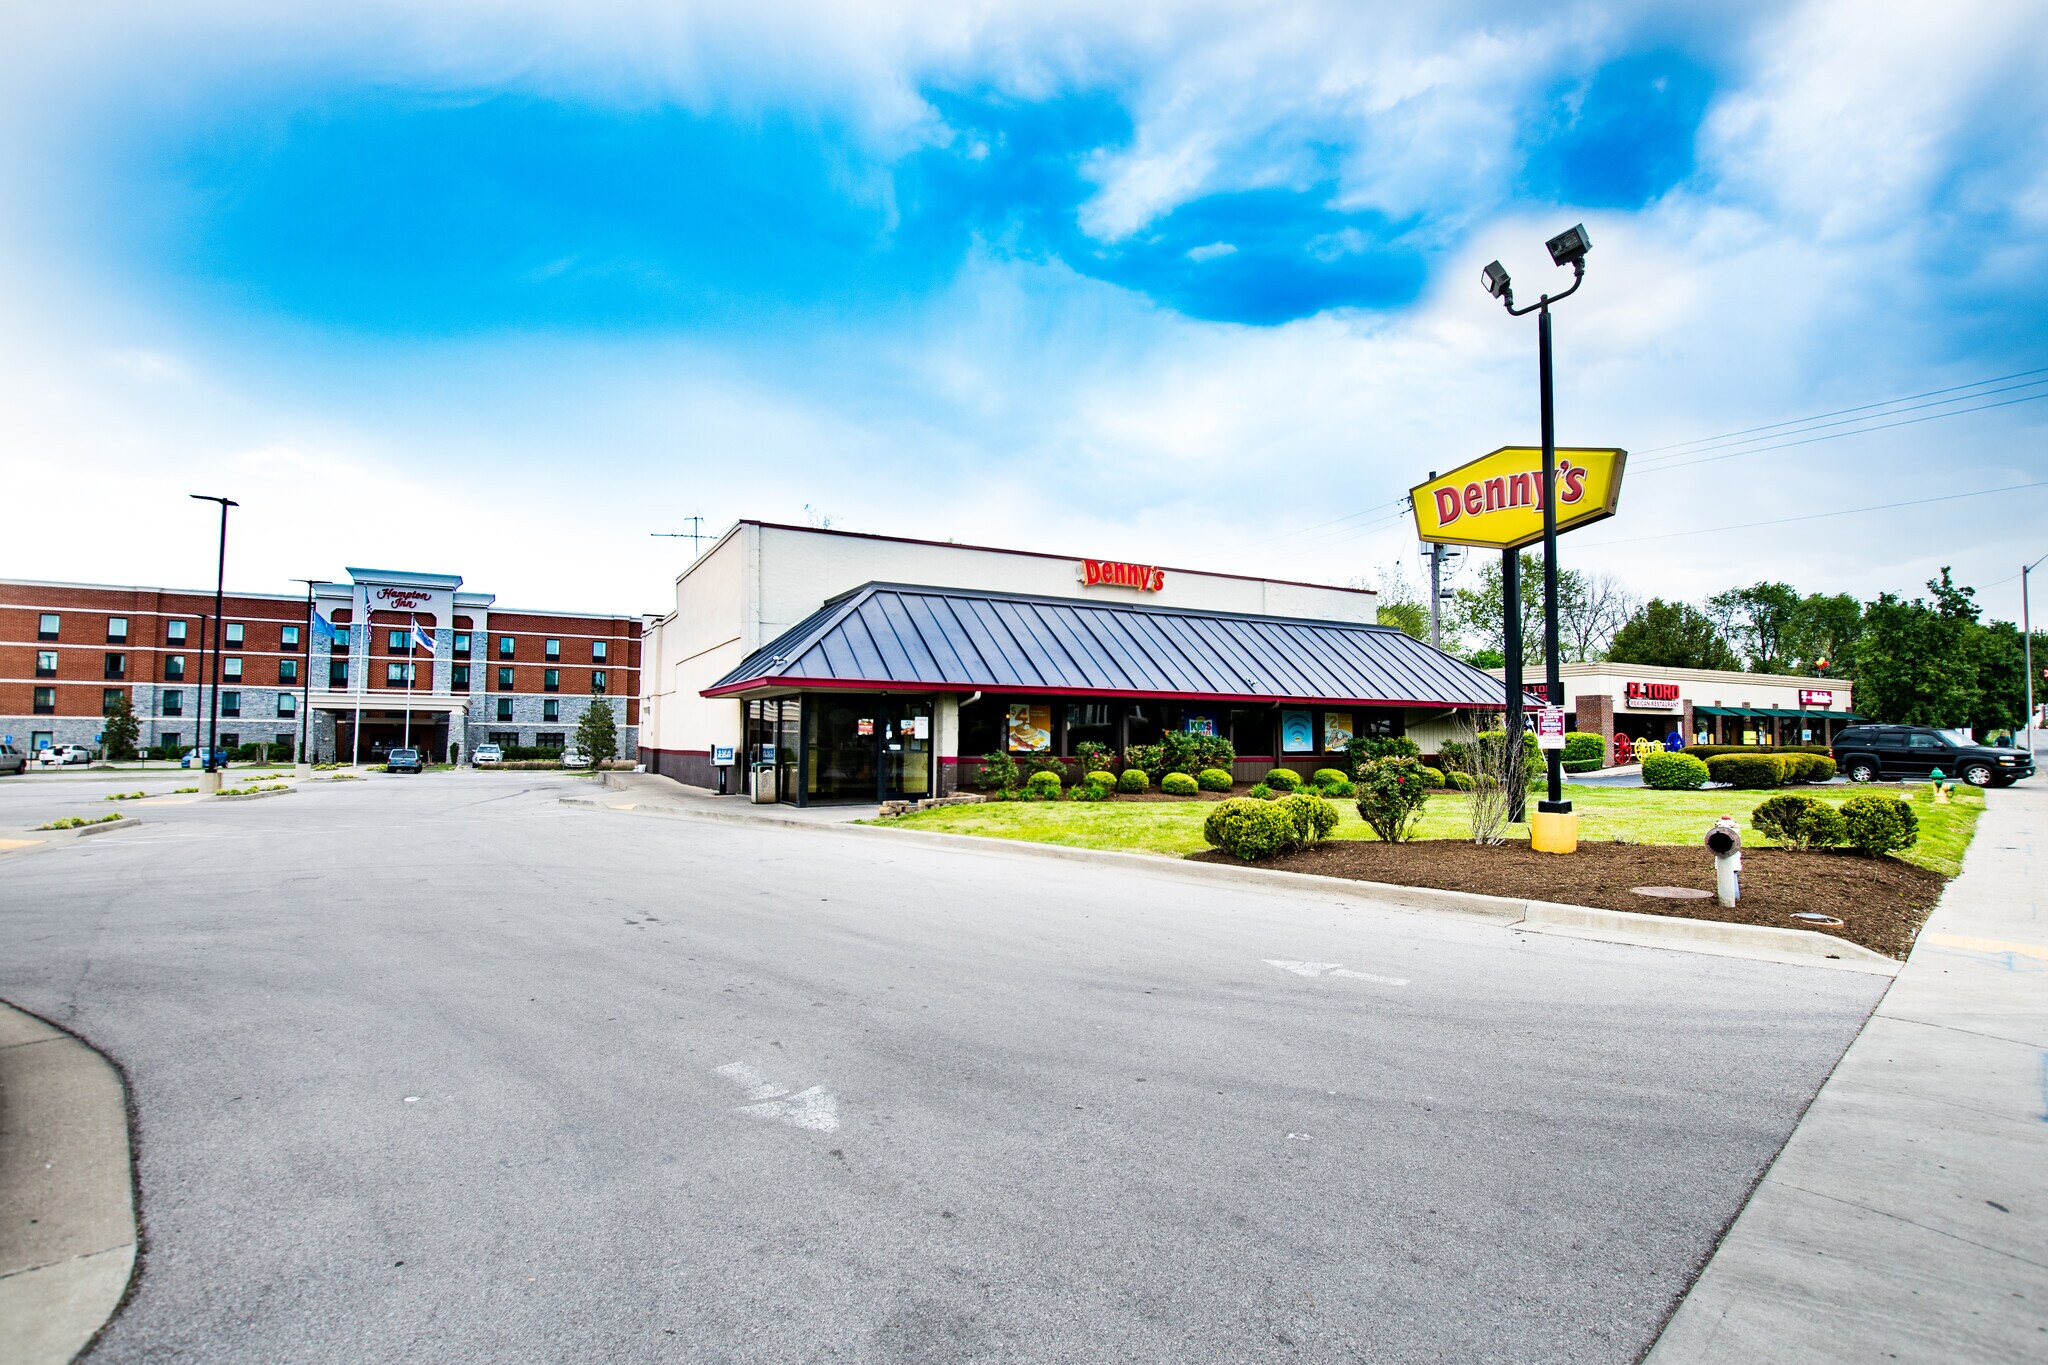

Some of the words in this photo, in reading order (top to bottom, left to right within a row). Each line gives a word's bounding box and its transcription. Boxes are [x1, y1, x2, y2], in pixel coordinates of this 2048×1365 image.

[1433, 459, 1587, 528] Denny's
[1081, 559, 1165, 592] Denny's
[377, 588, 431, 601] Hampton
[391, 598, 417, 609] Inn
[1627, 682, 1645, 699] EL
[1644, 683, 1680, 700] TORO
[1190, 720, 1212, 731] KIDS
